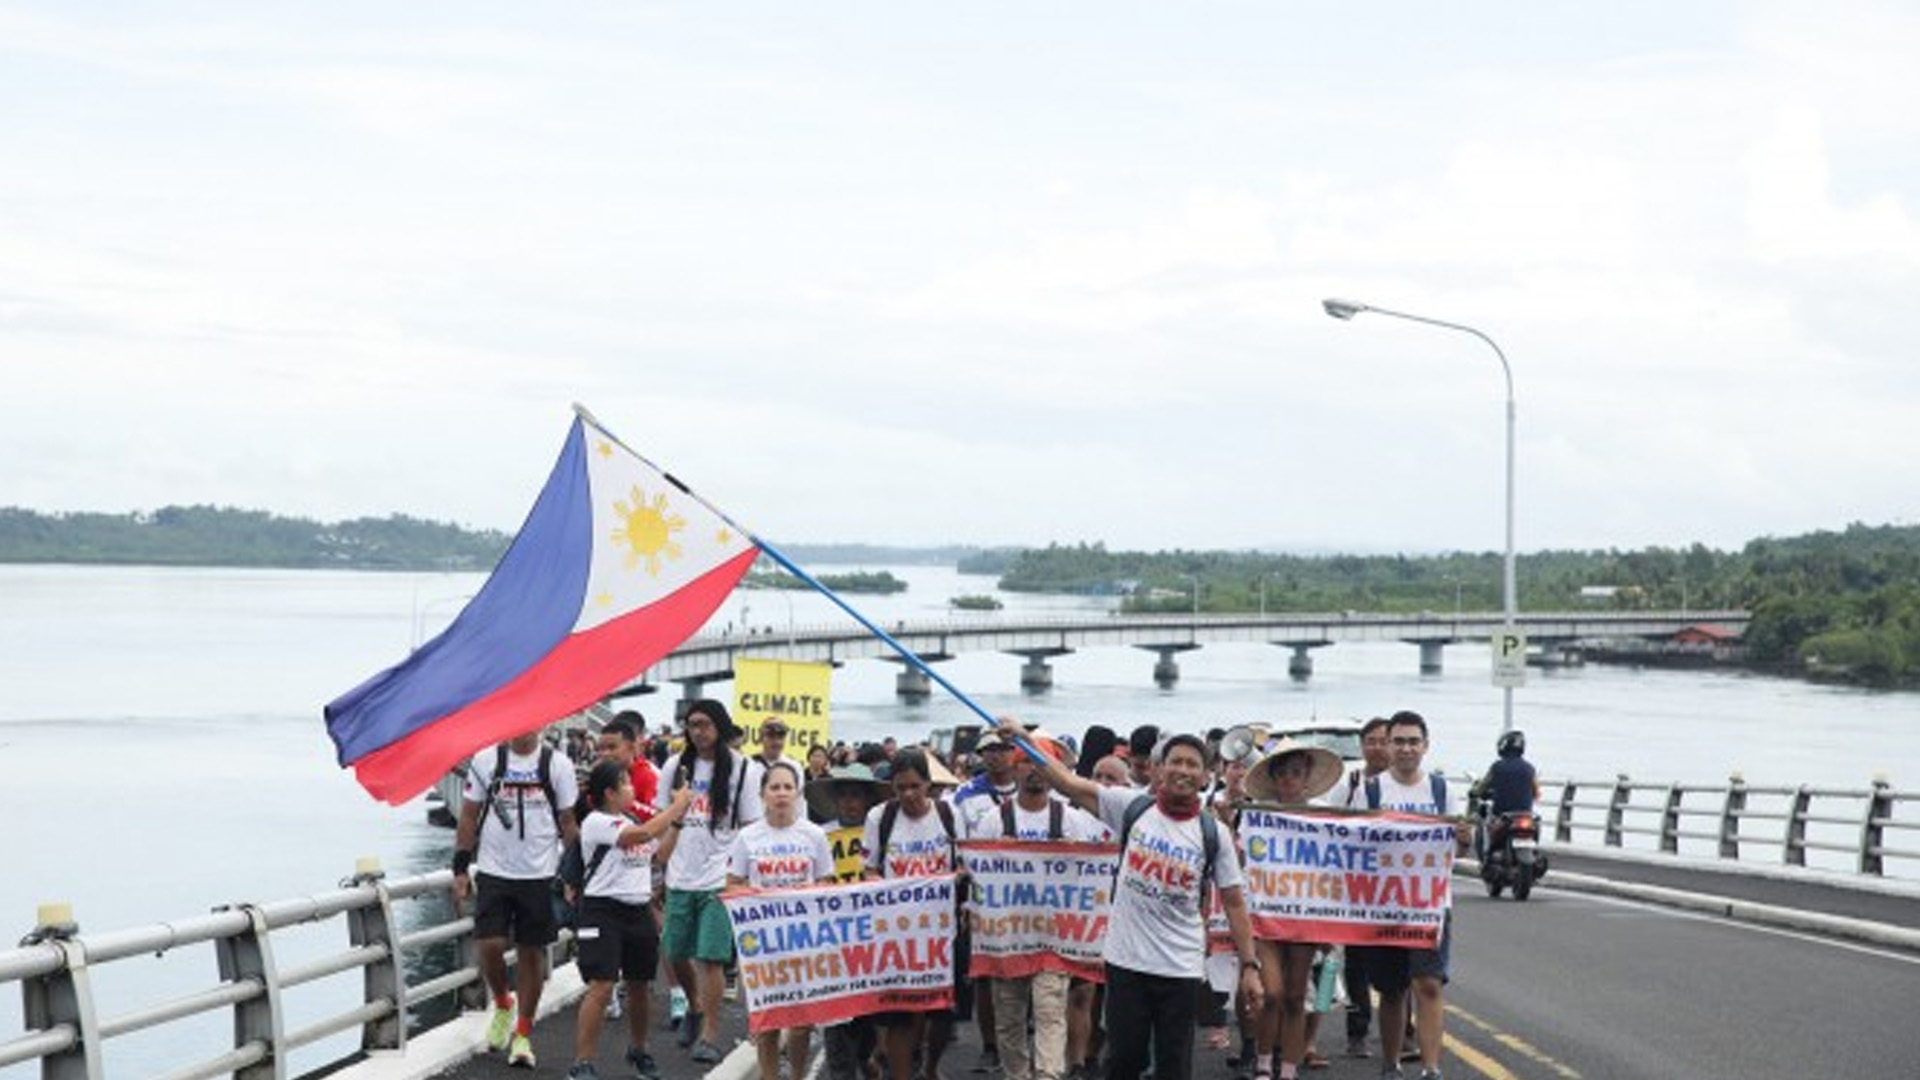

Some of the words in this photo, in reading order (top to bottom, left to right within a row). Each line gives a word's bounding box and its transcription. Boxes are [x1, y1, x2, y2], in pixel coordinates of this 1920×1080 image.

[1503, 635, 1519, 657] P
[740, 692, 822, 716] CLIMATE
[743, 725, 820, 747] JUICE
[1247, 812, 1320, 834] MANILA
[1324, 823, 1349, 837] TO
[891, 855, 947, 877] WALK
[1044, 860, 1067, 874] TO
[1248, 836, 1378, 872] CLIMATE
[1129, 850, 1196, 892] WALK
[972, 883, 1096, 911] CLIMATE
[1249, 868, 1342, 901] JUSTICE
[1343, 873, 1447, 908] WALK
[732, 901, 808, 925] MANILA
[816, 897, 842, 914] TO
[852, 884, 950, 911] TACLOBAN
[737, 914, 873, 957] CLIMATE
[743, 952, 843, 990] JUSTICE
[842, 936, 949, 977] WALK
